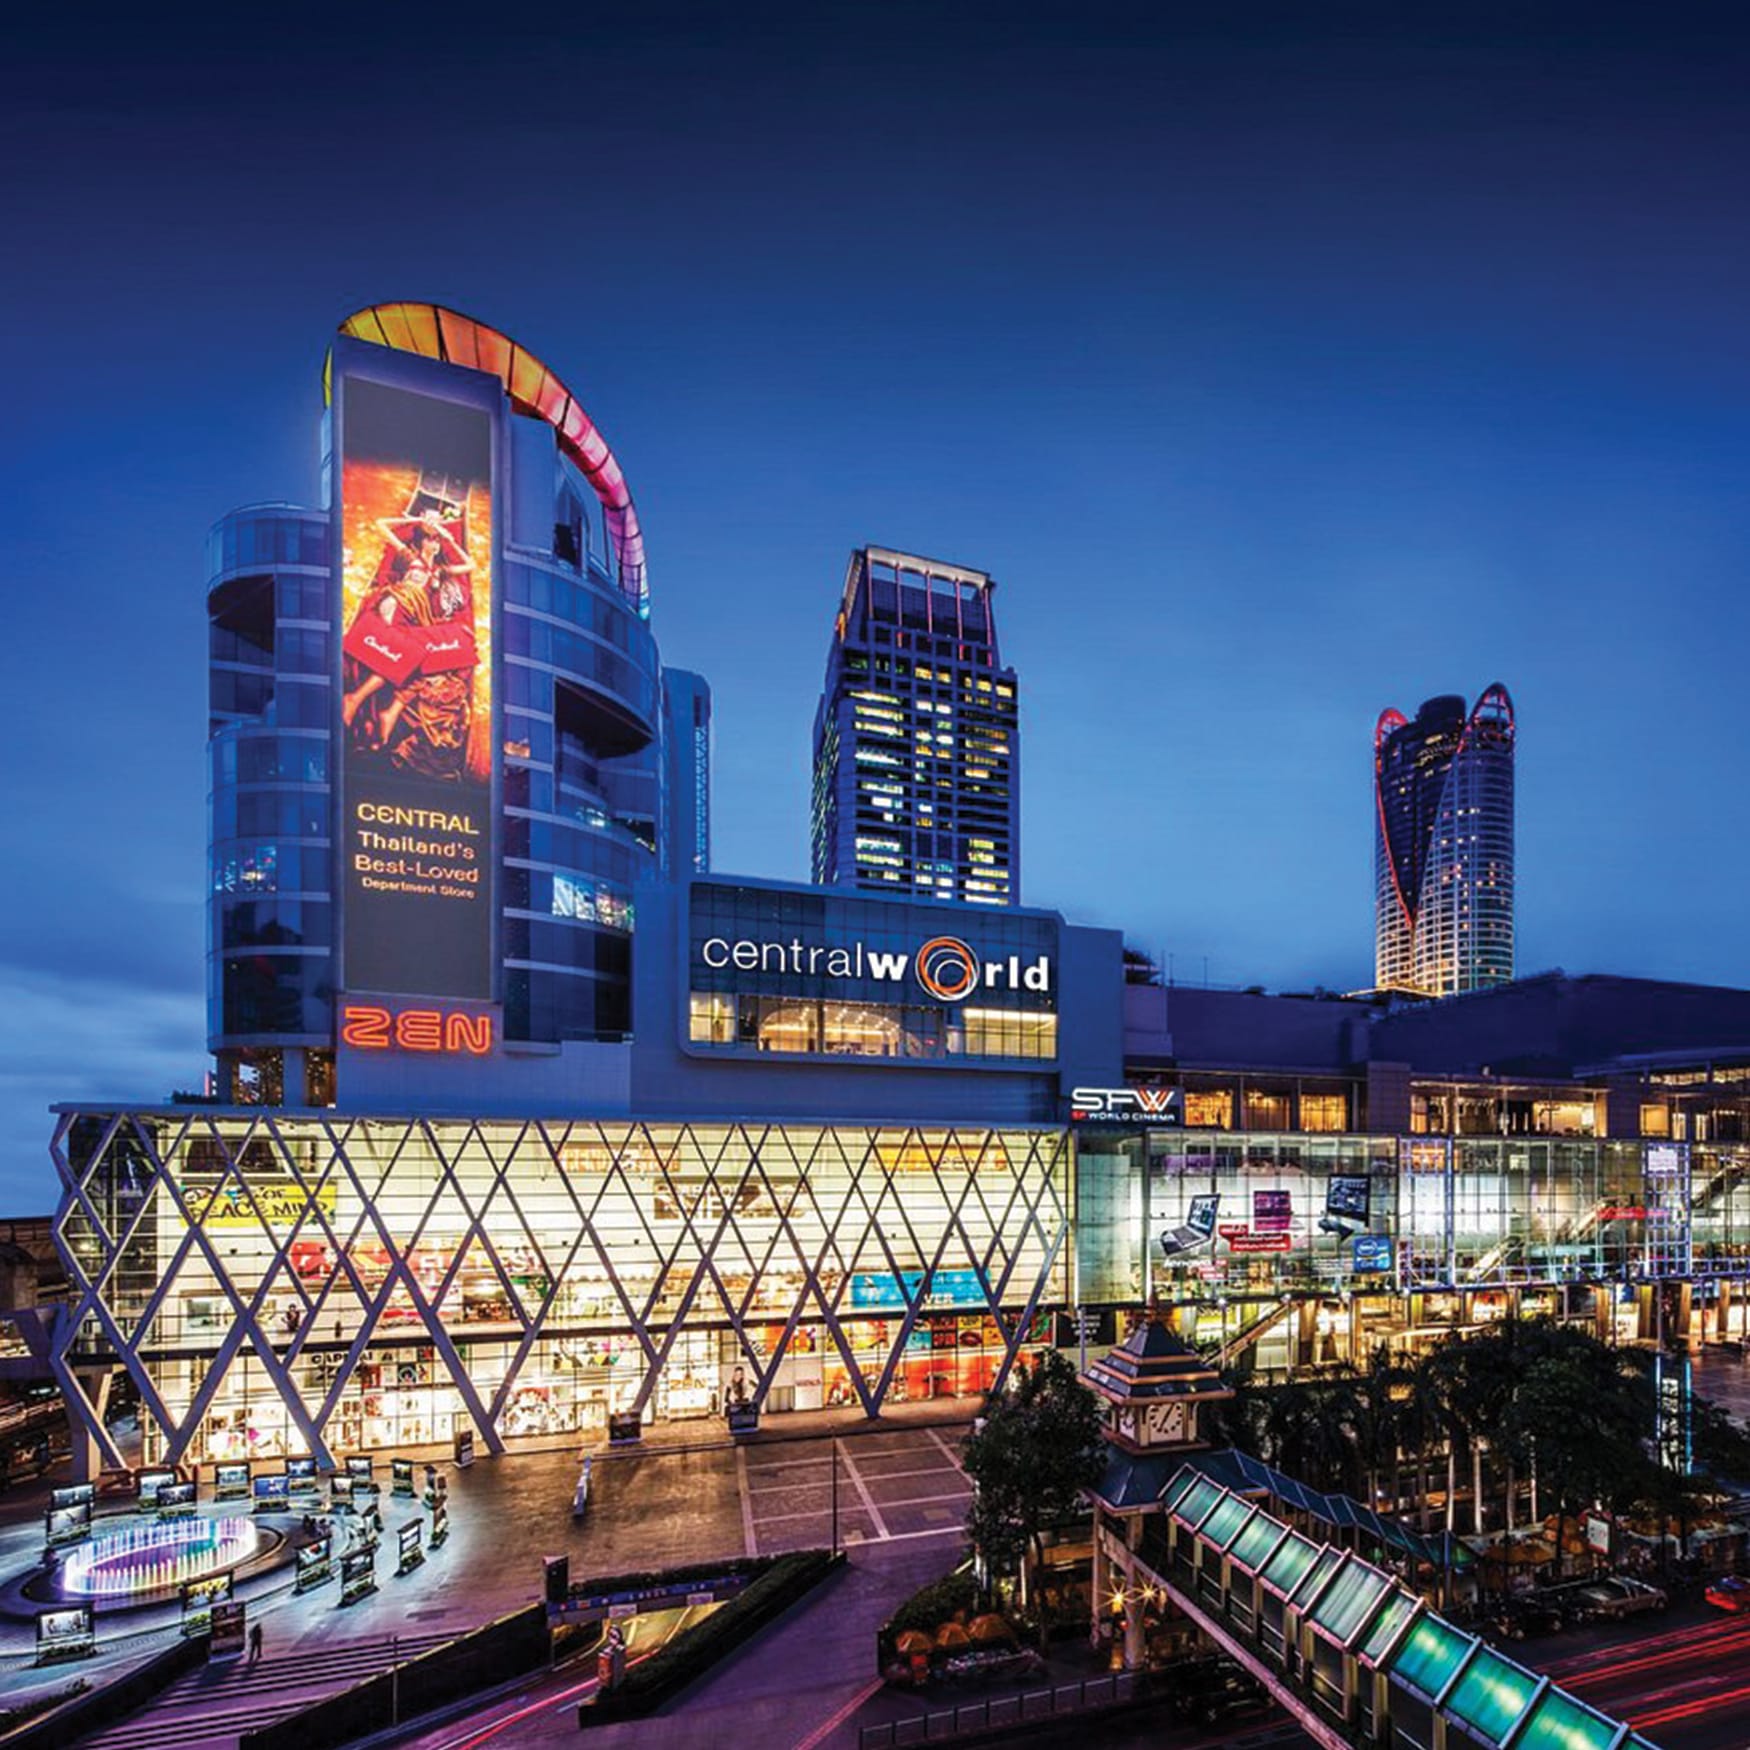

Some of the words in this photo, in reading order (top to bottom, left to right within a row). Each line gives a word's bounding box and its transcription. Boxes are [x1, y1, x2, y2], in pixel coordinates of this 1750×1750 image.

[357, 803, 480, 835] CENTRAL
[357, 830, 475, 860] Thailand's
[355, 854, 479, 883] Best-Loved
[362, 876, 436, 895] Department
[441, 885, 475, 899] Store
[342, 1006, 491, 1054] ZEN
[1088, 1112, 1130, 1120] WORLD
[1132, 1112, 1175, 1121] CINEMA
